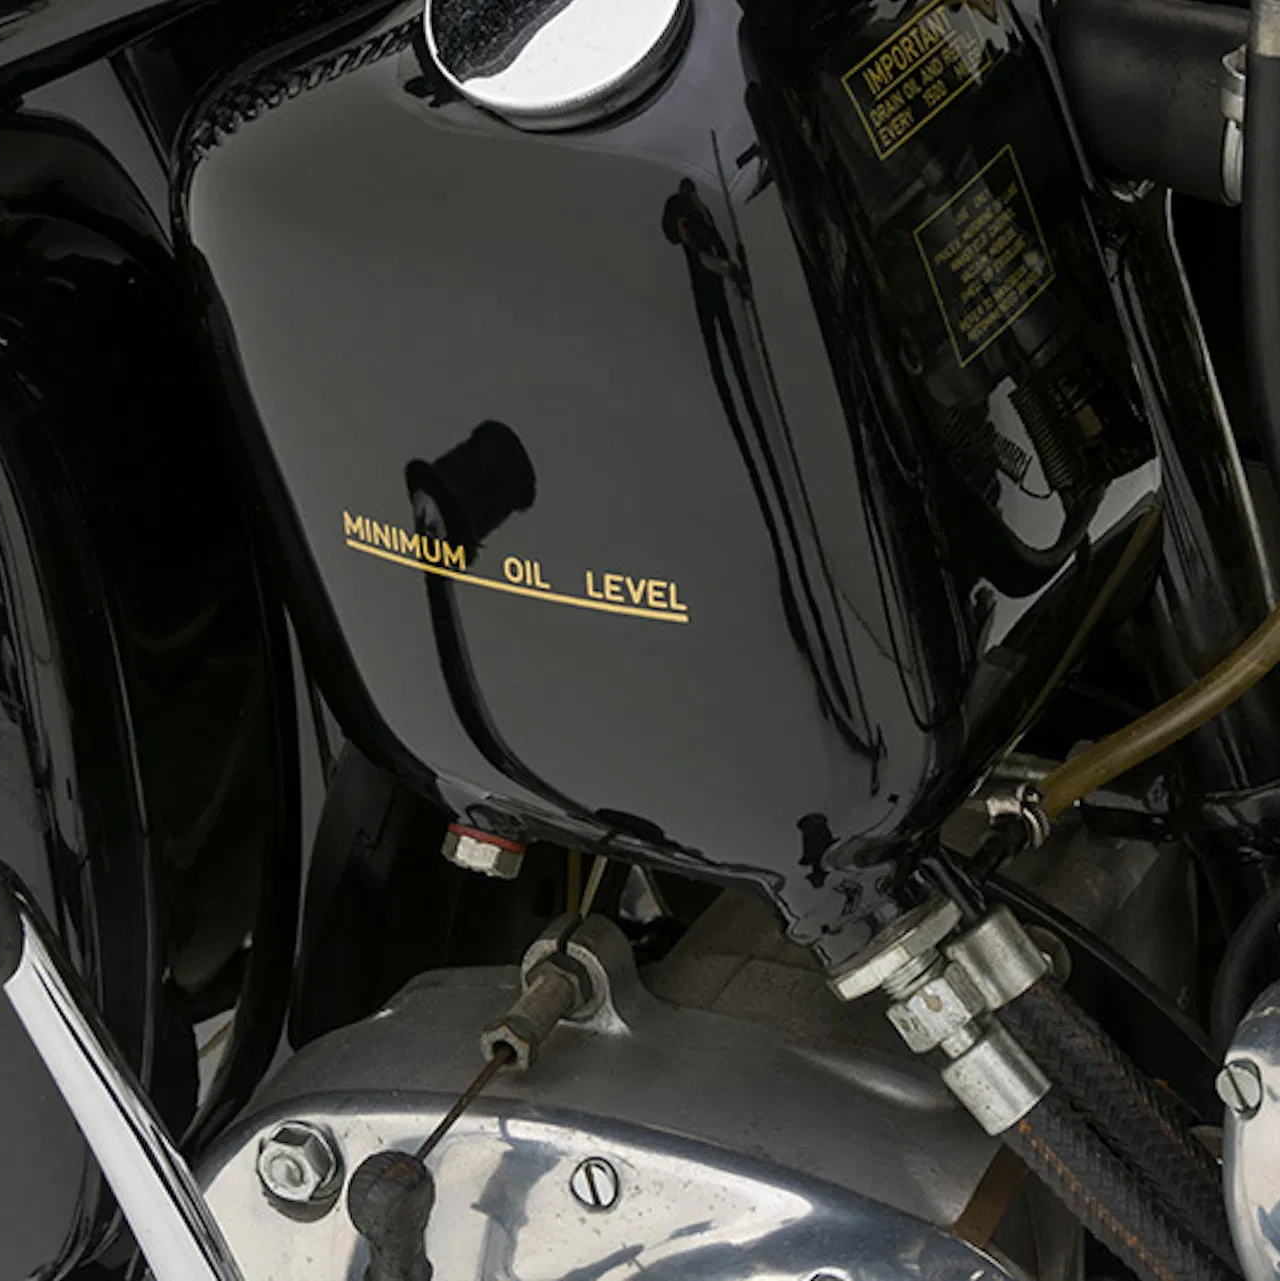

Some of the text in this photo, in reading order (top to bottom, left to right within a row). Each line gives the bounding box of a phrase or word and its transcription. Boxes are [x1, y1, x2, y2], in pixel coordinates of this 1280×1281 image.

[862, 4, 953, 95] IMPORTANT
[870, 90, 905, 128] DRAIN
[902, 78, 922, 100] OIL
[920, 56, 944, 85] AND
[878, 106, 915, 147] EVERY
[342, 510, 688, 612] MINIMUM OIL LEVEL
